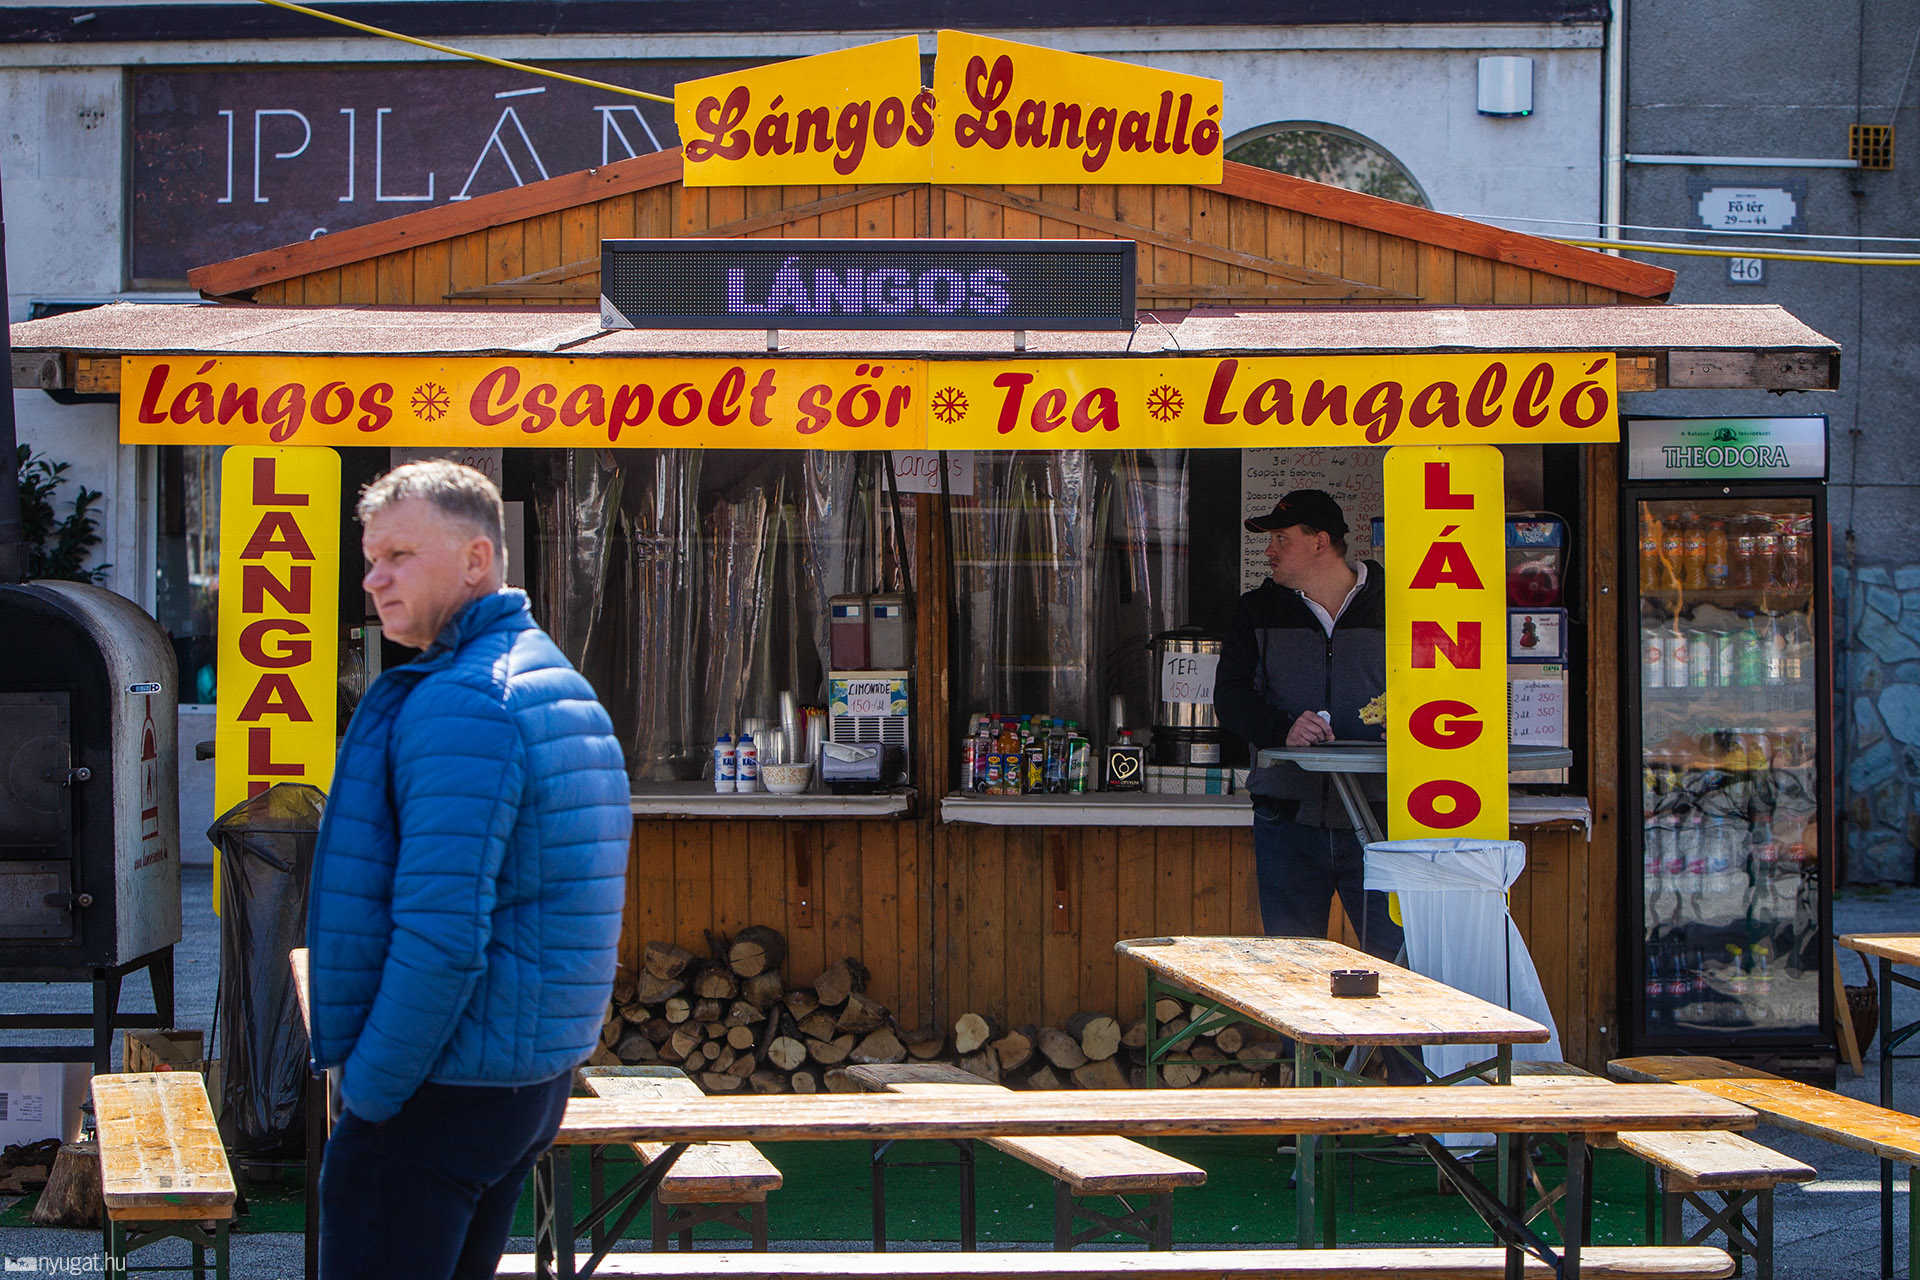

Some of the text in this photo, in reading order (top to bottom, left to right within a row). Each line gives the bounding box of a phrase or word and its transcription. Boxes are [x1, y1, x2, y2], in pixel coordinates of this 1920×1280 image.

[686, 55, 1221, 175] Lángos Langalló
[1724, 215, 1738, 225] 29
[728, 256, 1010, 313] LÁNGOS
[1733, 259, 1760, 279] 46
[138, 360, 393, 442] Lángos
[470, 363, 777, 441] Csapolt
[993, 372, 1120, 434] Tea
[1204, 359, 1608, 443] Langalló
[1662, 446, 1790, 468] THEODORA
[236, 457, 316, 797] LANGAL
[1168, 658, 1198, 675] TEA
